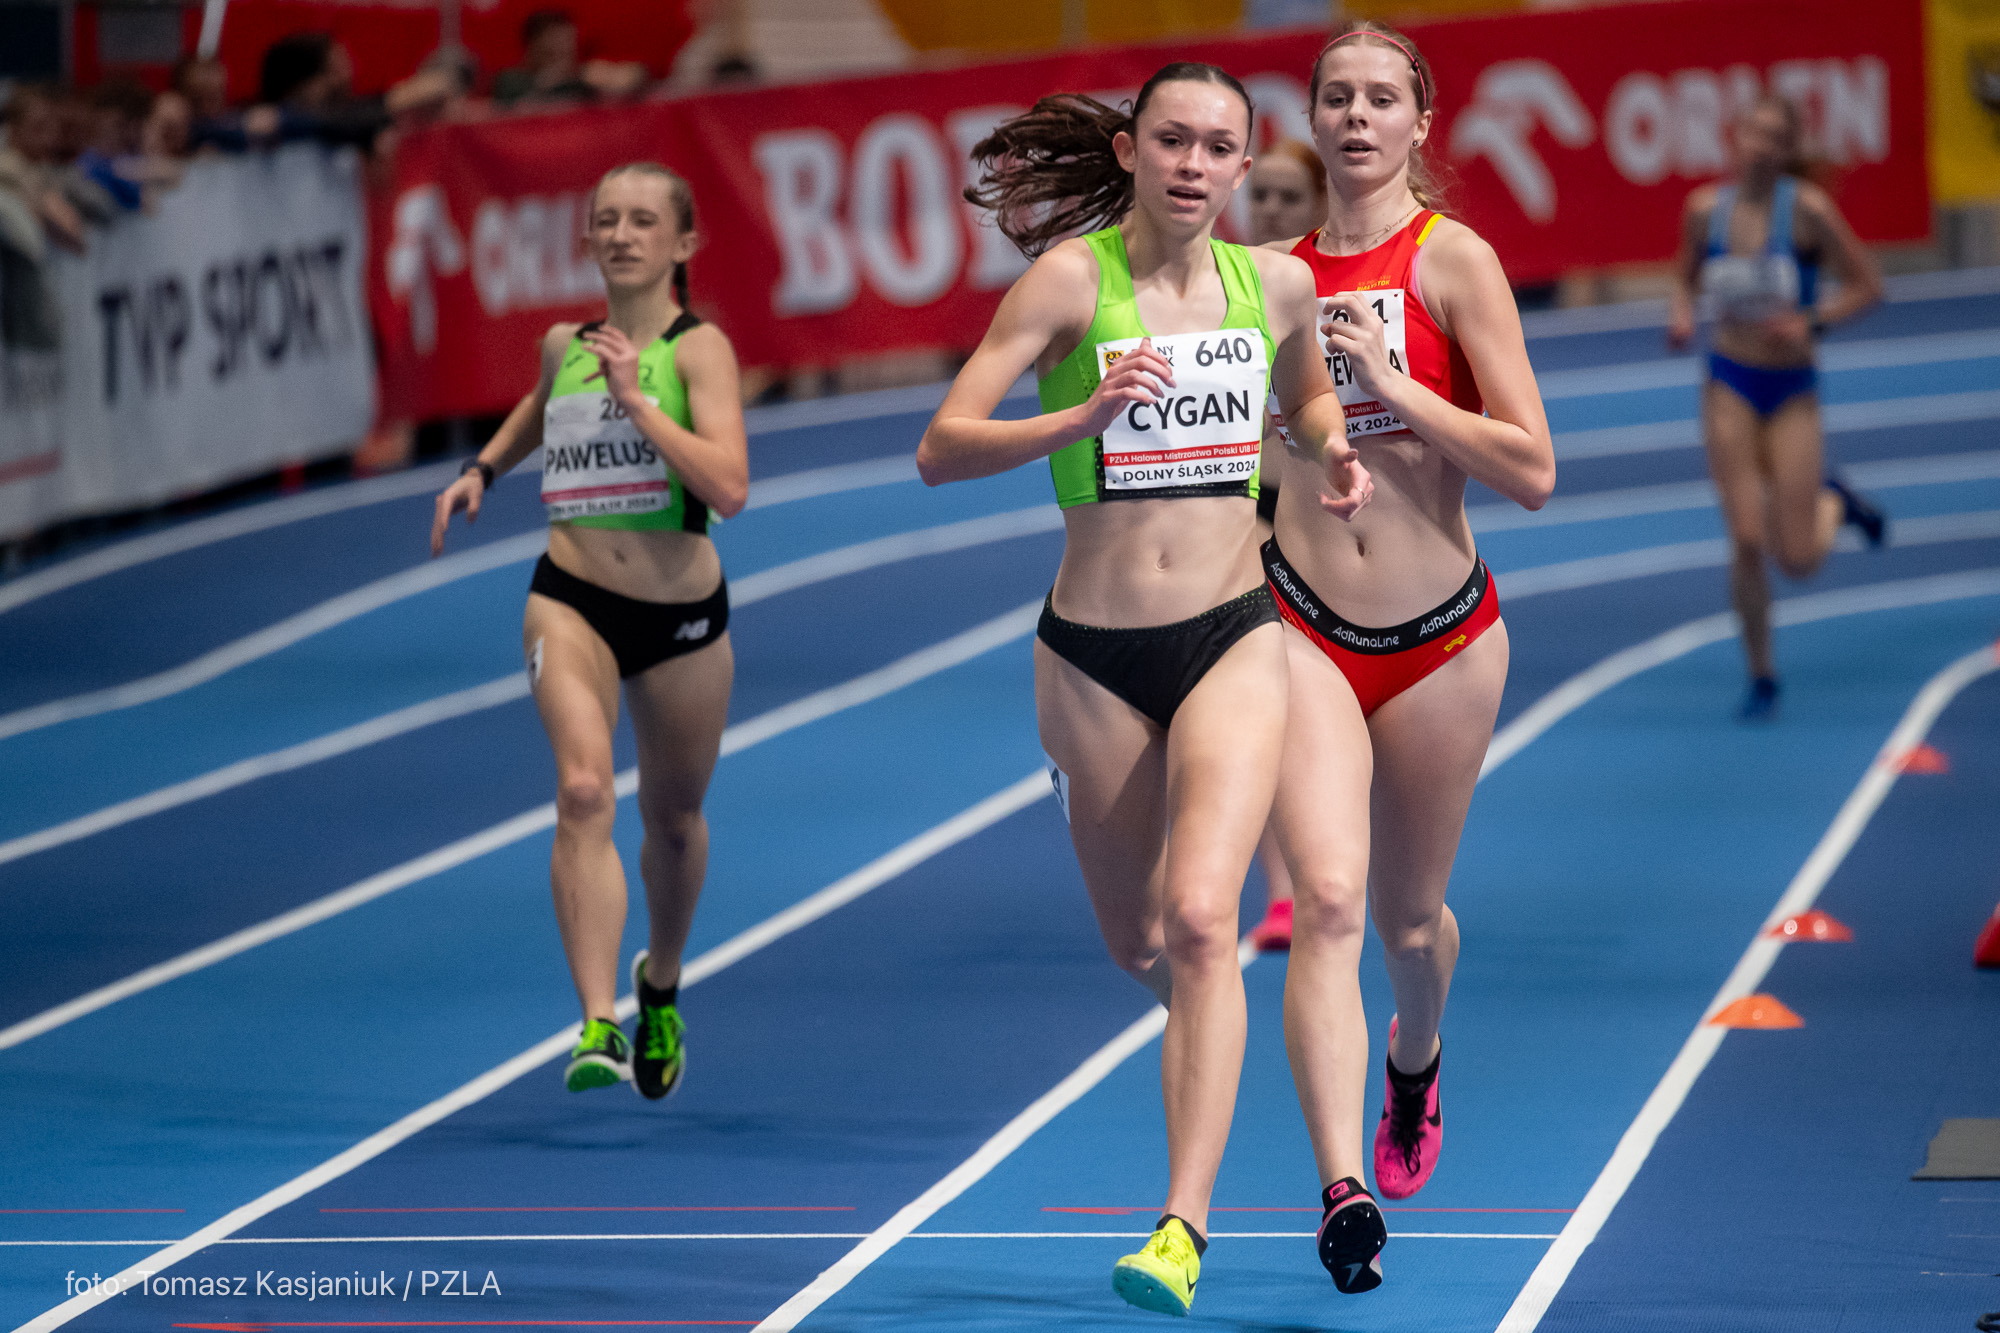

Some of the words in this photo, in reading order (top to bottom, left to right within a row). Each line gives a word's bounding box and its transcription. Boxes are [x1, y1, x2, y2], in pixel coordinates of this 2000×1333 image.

[1333, 299, 1388, 323] 61
[1195, 337, 1252, 367] 640
[1128, 390, 1250, 432] CYGAN
[1349, 403, 1373, 415] Polski
[1109, 455, 1129, 464] PZLA
[1131, 453, 1163, 463] Halowe
[1164, 449, 1212, 461] Mistrzostwa
[1213, 445, 1238, 456] Polski
[1239, 444, 1251, 454] U18
[1123, 468, 1175, 482] DOLNY
[1178, 464, 1224, 479] ŚLĄSK
[1227, 460, 1256, 474] 2024
